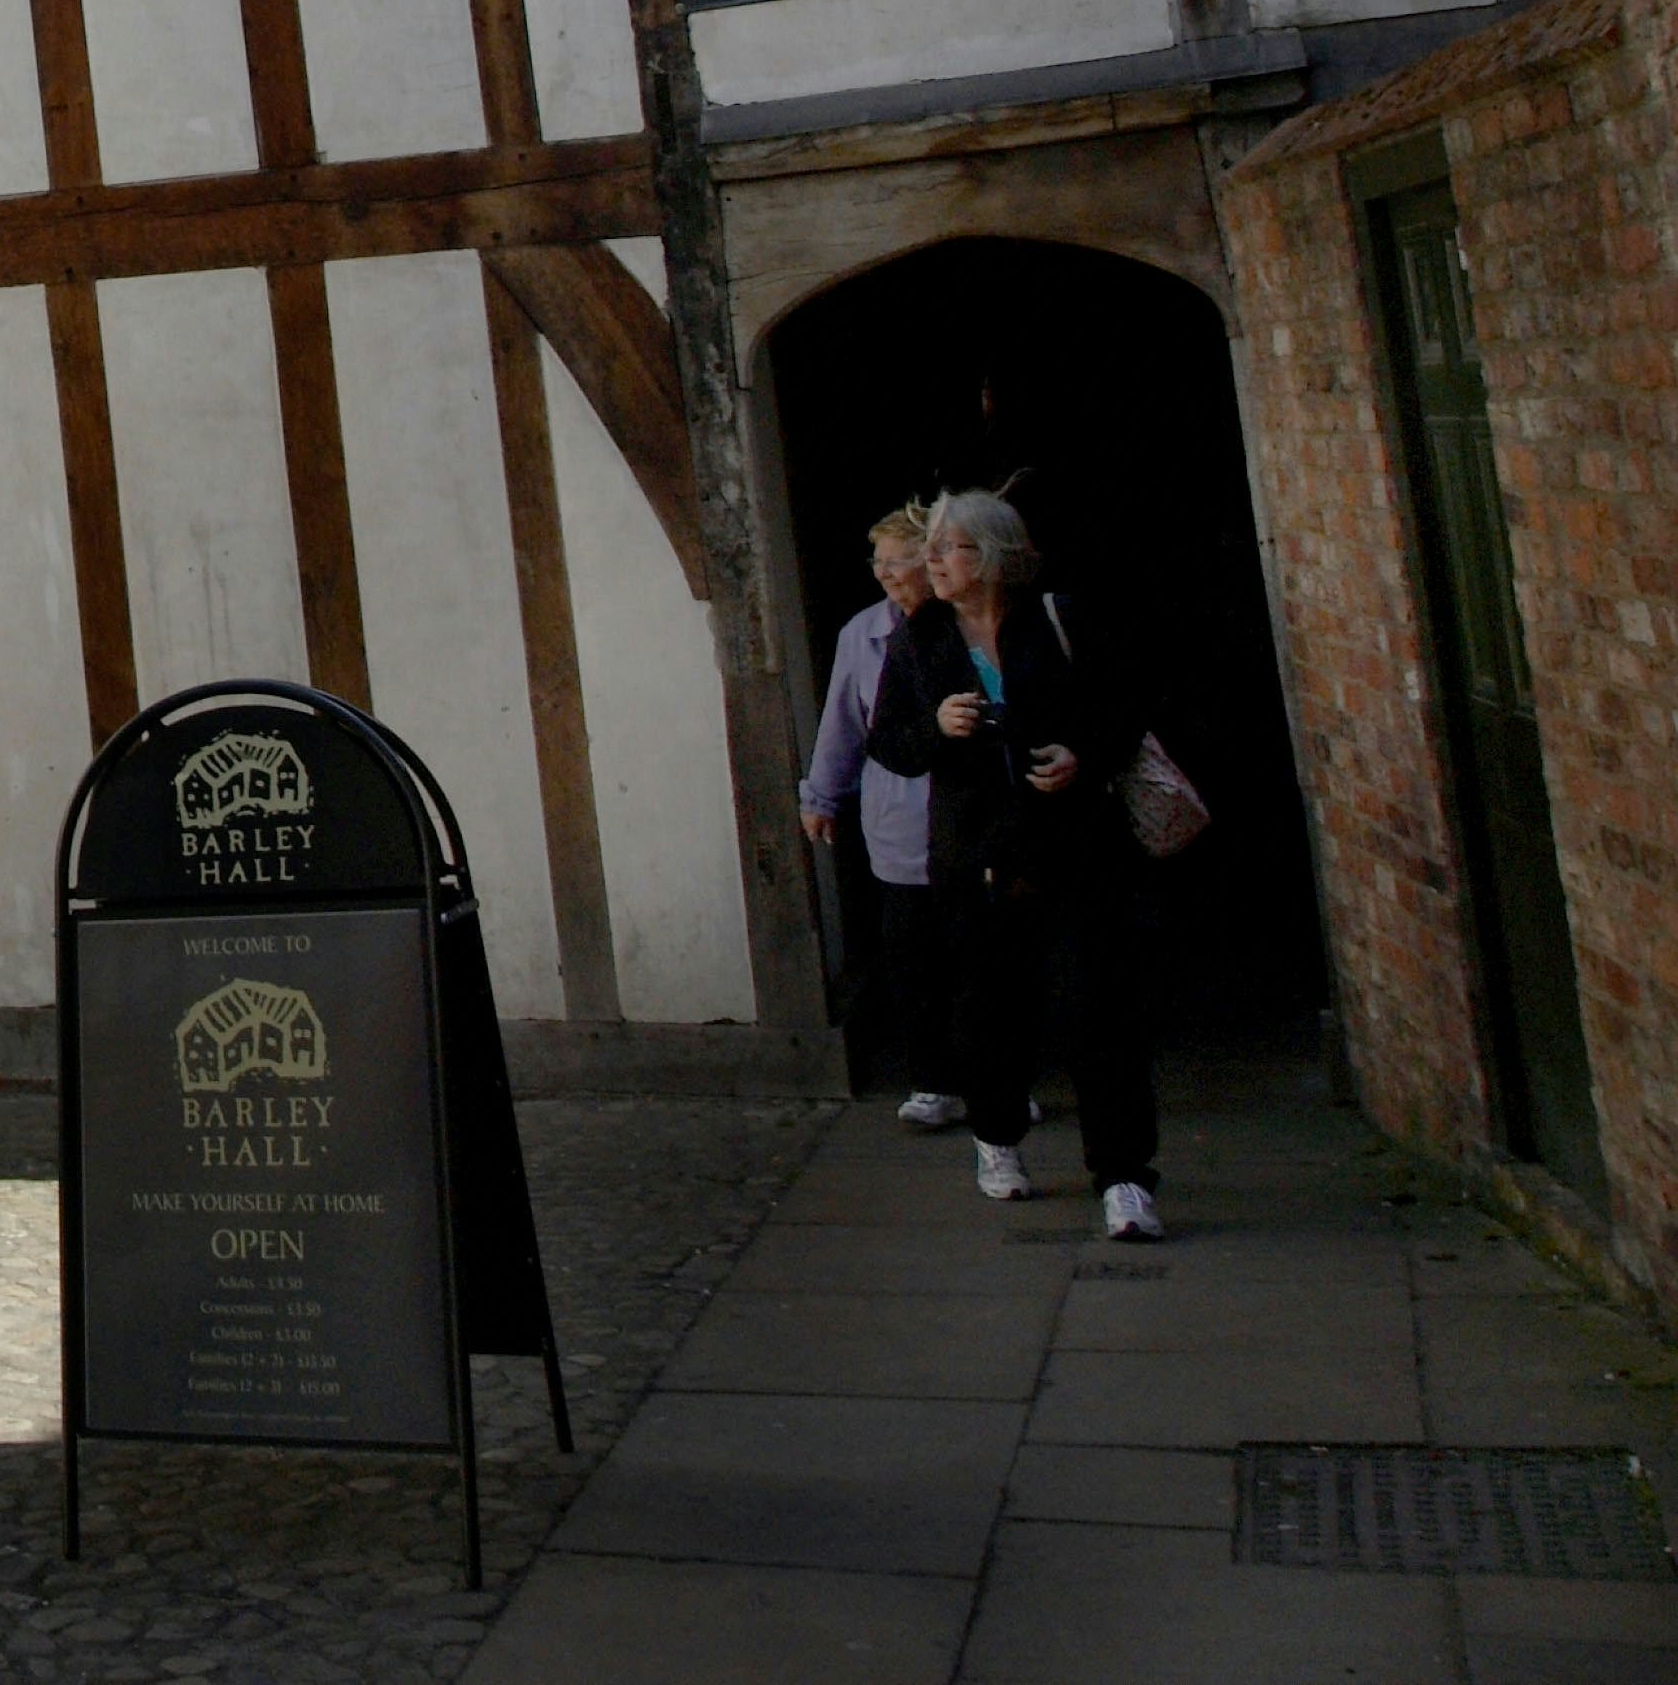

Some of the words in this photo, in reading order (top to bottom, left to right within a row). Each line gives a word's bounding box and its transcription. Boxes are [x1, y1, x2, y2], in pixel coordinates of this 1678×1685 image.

[182, 824, 315, 857] BARLEY
[183, 935, 277, 956] WELCOME
[285, 934, 312, 953] TO
[182, 1096, 336, 1129] BARLEY
[132, 1193, 185, 1212] MAKE
[189, 1193, 286, 1213] YOURSELF
[292, 1194, 317, 1212] AT
[324, 1194, 386, 1213] HOME
[210, 1229, 305, 1260] OPEN
